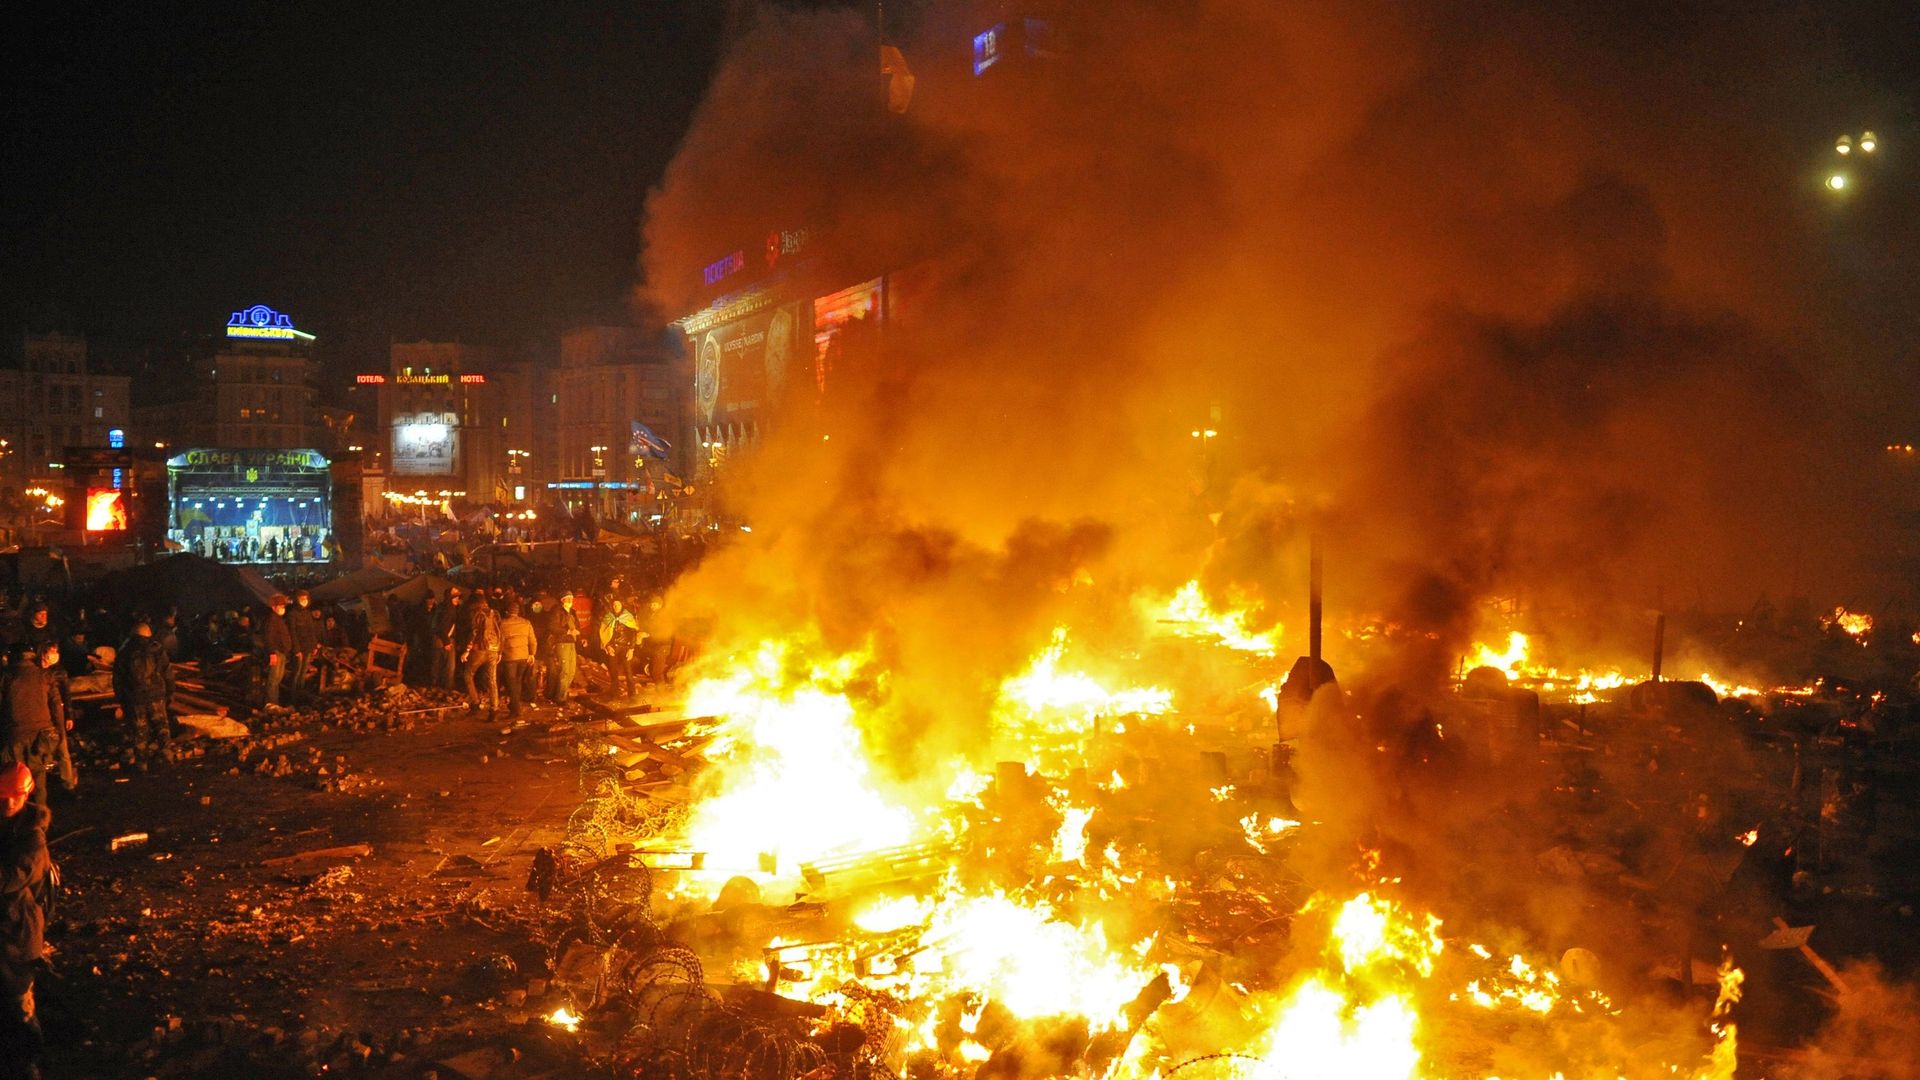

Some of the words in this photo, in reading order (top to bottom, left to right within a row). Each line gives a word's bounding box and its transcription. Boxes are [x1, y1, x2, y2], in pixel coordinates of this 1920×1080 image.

[356, 375, 385, 384] ГОТЕЛЬ
[396, 375, 449, 385] КОЗАЦЬКИЙ
[460, 375, 485, 383] HOTEL
[187, 451, 242, 465] СЛАВА
[247, 451, 311, 465] УКРАЇНІ
